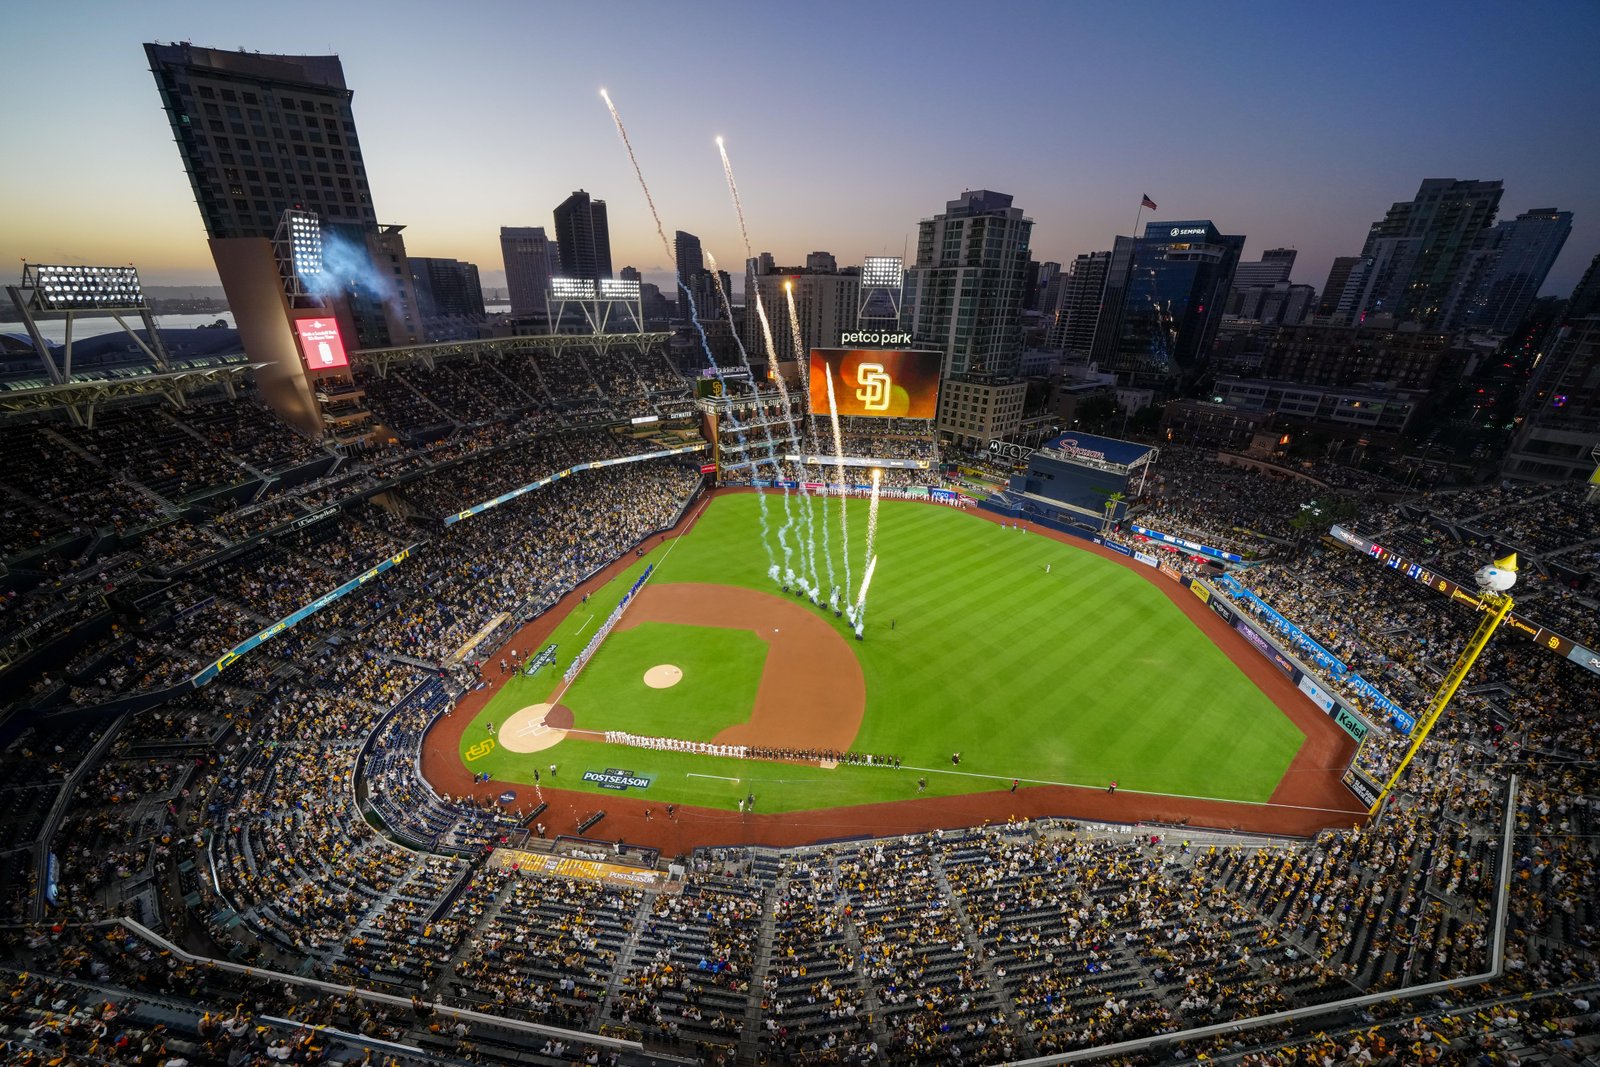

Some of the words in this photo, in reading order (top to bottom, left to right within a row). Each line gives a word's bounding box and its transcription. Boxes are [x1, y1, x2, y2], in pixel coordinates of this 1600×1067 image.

[841, 331, 879, 344] petco
[881, 333, 912, 345] park
[584, 772, 649, 787] POSTSEASON
[608, 871, 656, 884] POSTSEASON
